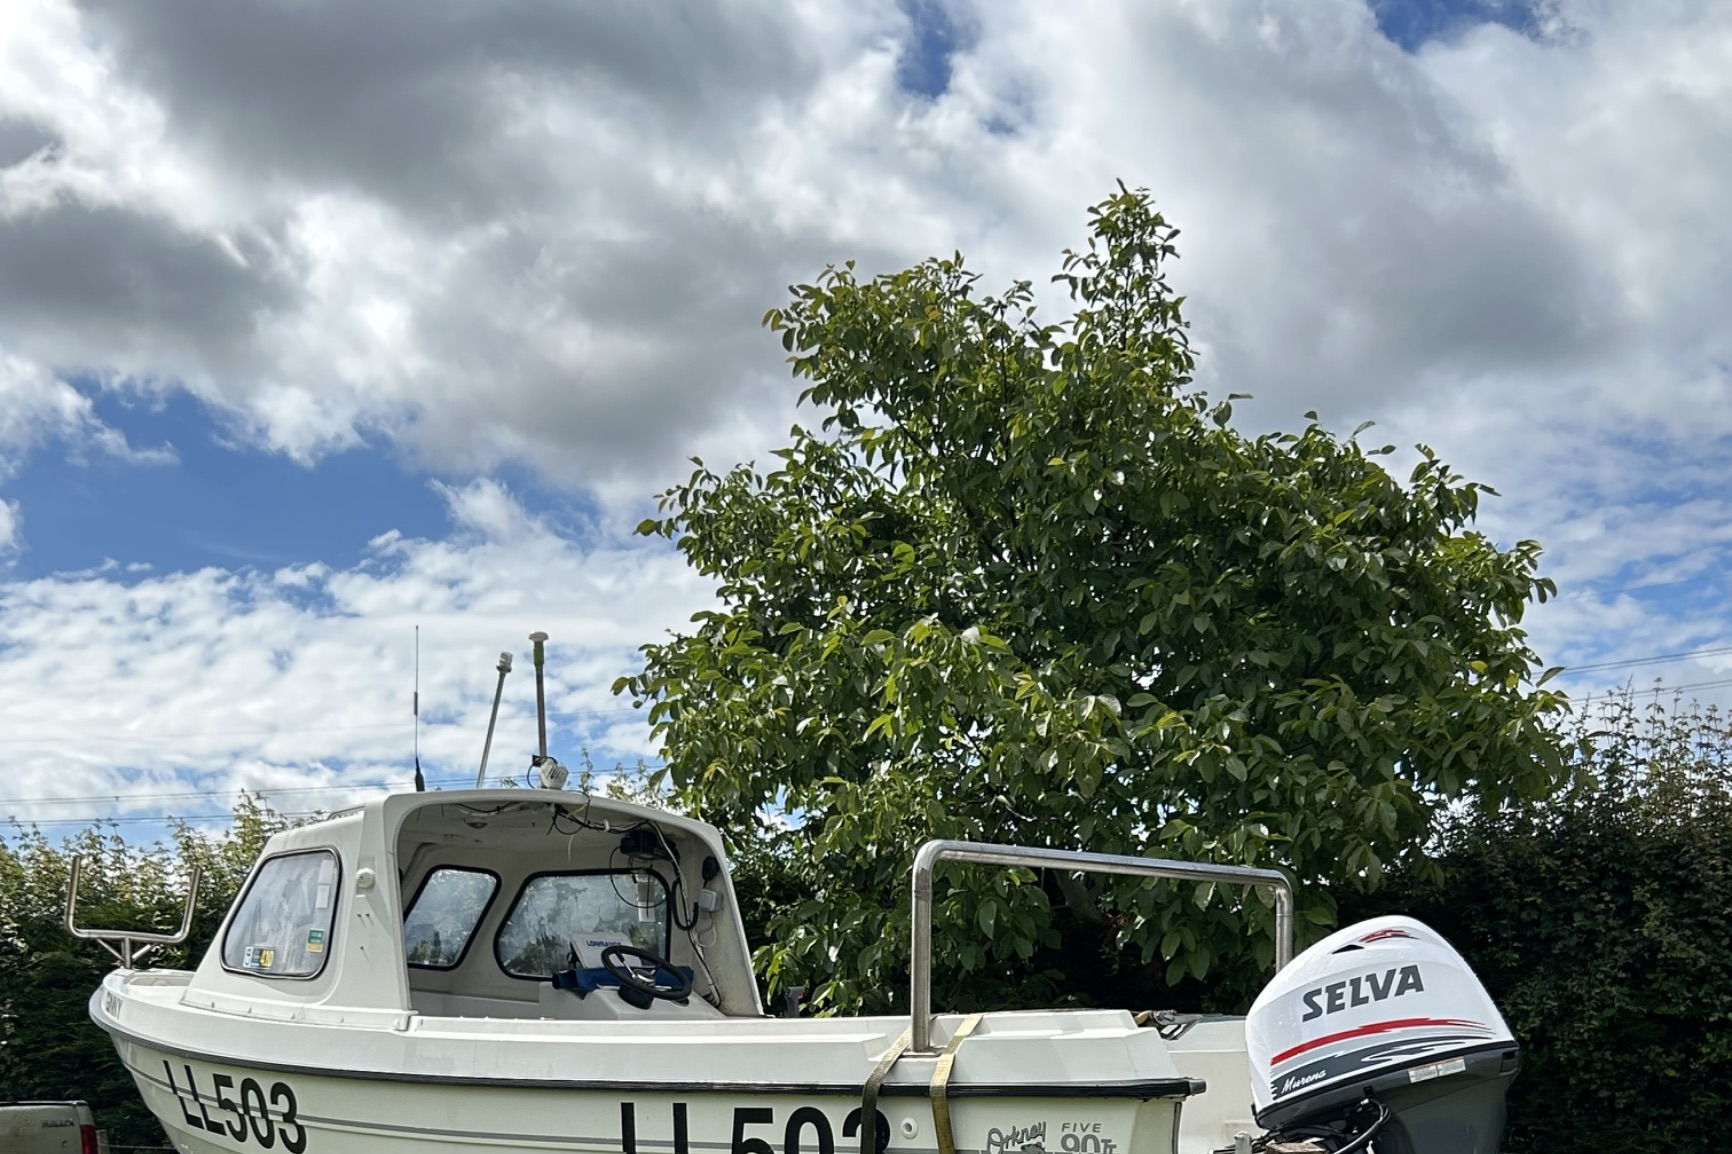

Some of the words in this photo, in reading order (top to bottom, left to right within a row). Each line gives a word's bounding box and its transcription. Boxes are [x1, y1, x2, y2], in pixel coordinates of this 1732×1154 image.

[1301, 964, 1425, 1023] SELVA
[1281, 1069, 1327, 1094] Murena
[163, 1060, 307, 1154] LL503
[1061, 1122, 1102, 1133] FIVE
